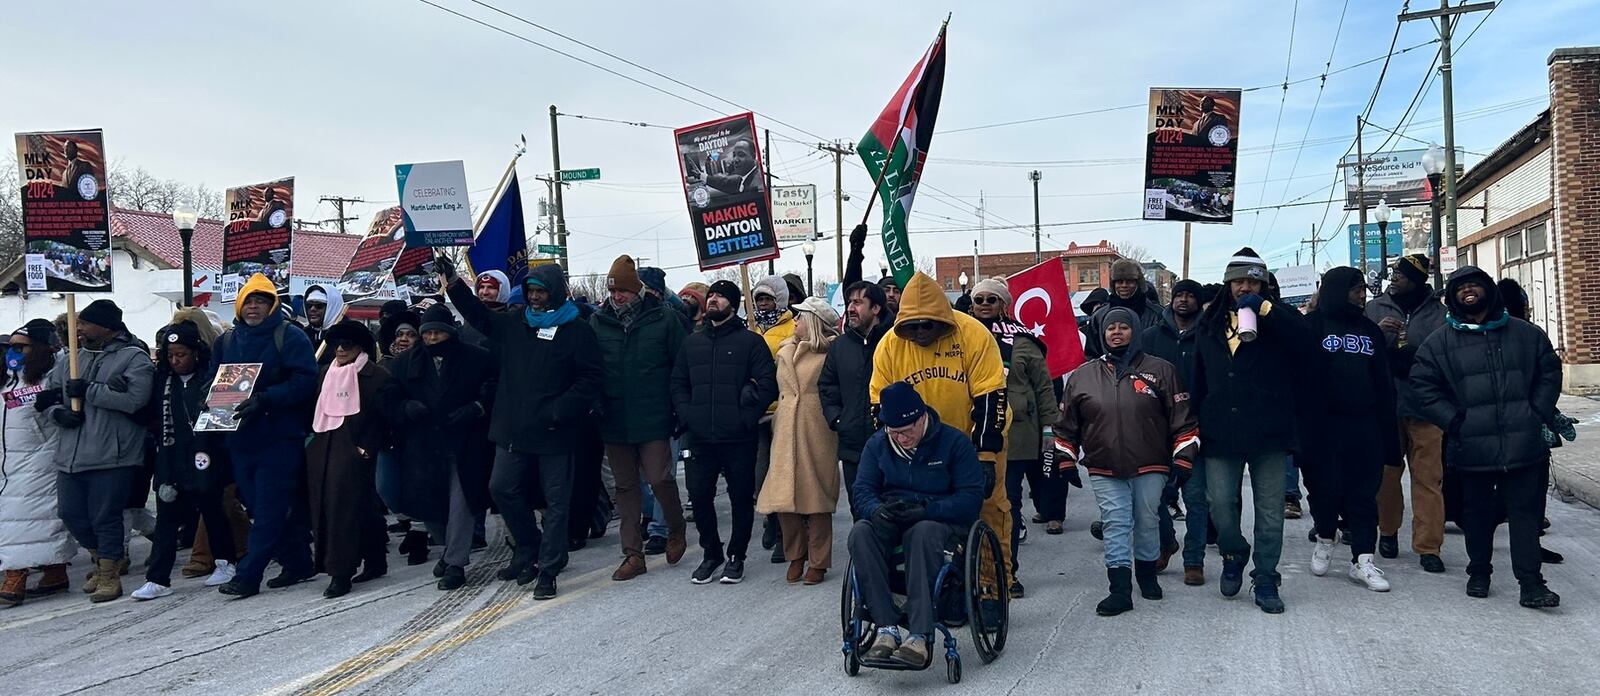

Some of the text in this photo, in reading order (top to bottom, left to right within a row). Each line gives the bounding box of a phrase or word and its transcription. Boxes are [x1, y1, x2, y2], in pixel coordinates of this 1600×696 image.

[1156, 105, 1184, 115] MLK
[1155, 119, 1184, 128] DAY
[1155, 129, 1184, 144] 2024
[698, 137, 728, 151] DAYTON
[24, 153, 51, 165] MLK
[1402, 162, 1414, 170] kid
[25, 168, 52, 180] DAY
[563, 171, 587, 180] MOUND
[27, 181, 55, 198] 2024
[413, 187, 456, 198] CELEBRATING
[775, 188, 809, 199] Tasty
[231, 199, 252, 210] MLK
[410, 203, 426, 211] Martin
[426, 203, 443, 211] Luther
[443, 202, 456, 211] King
[230, 210, 252, 221] DAY
[702, 202, 758, 225] MAKING
[229, 219, 251, 234] 2024
[704, 217, 762, 241] DAYTON
[707, 233, 764, 256] BETTER!
[28, 272, 44, 280] FOOD
